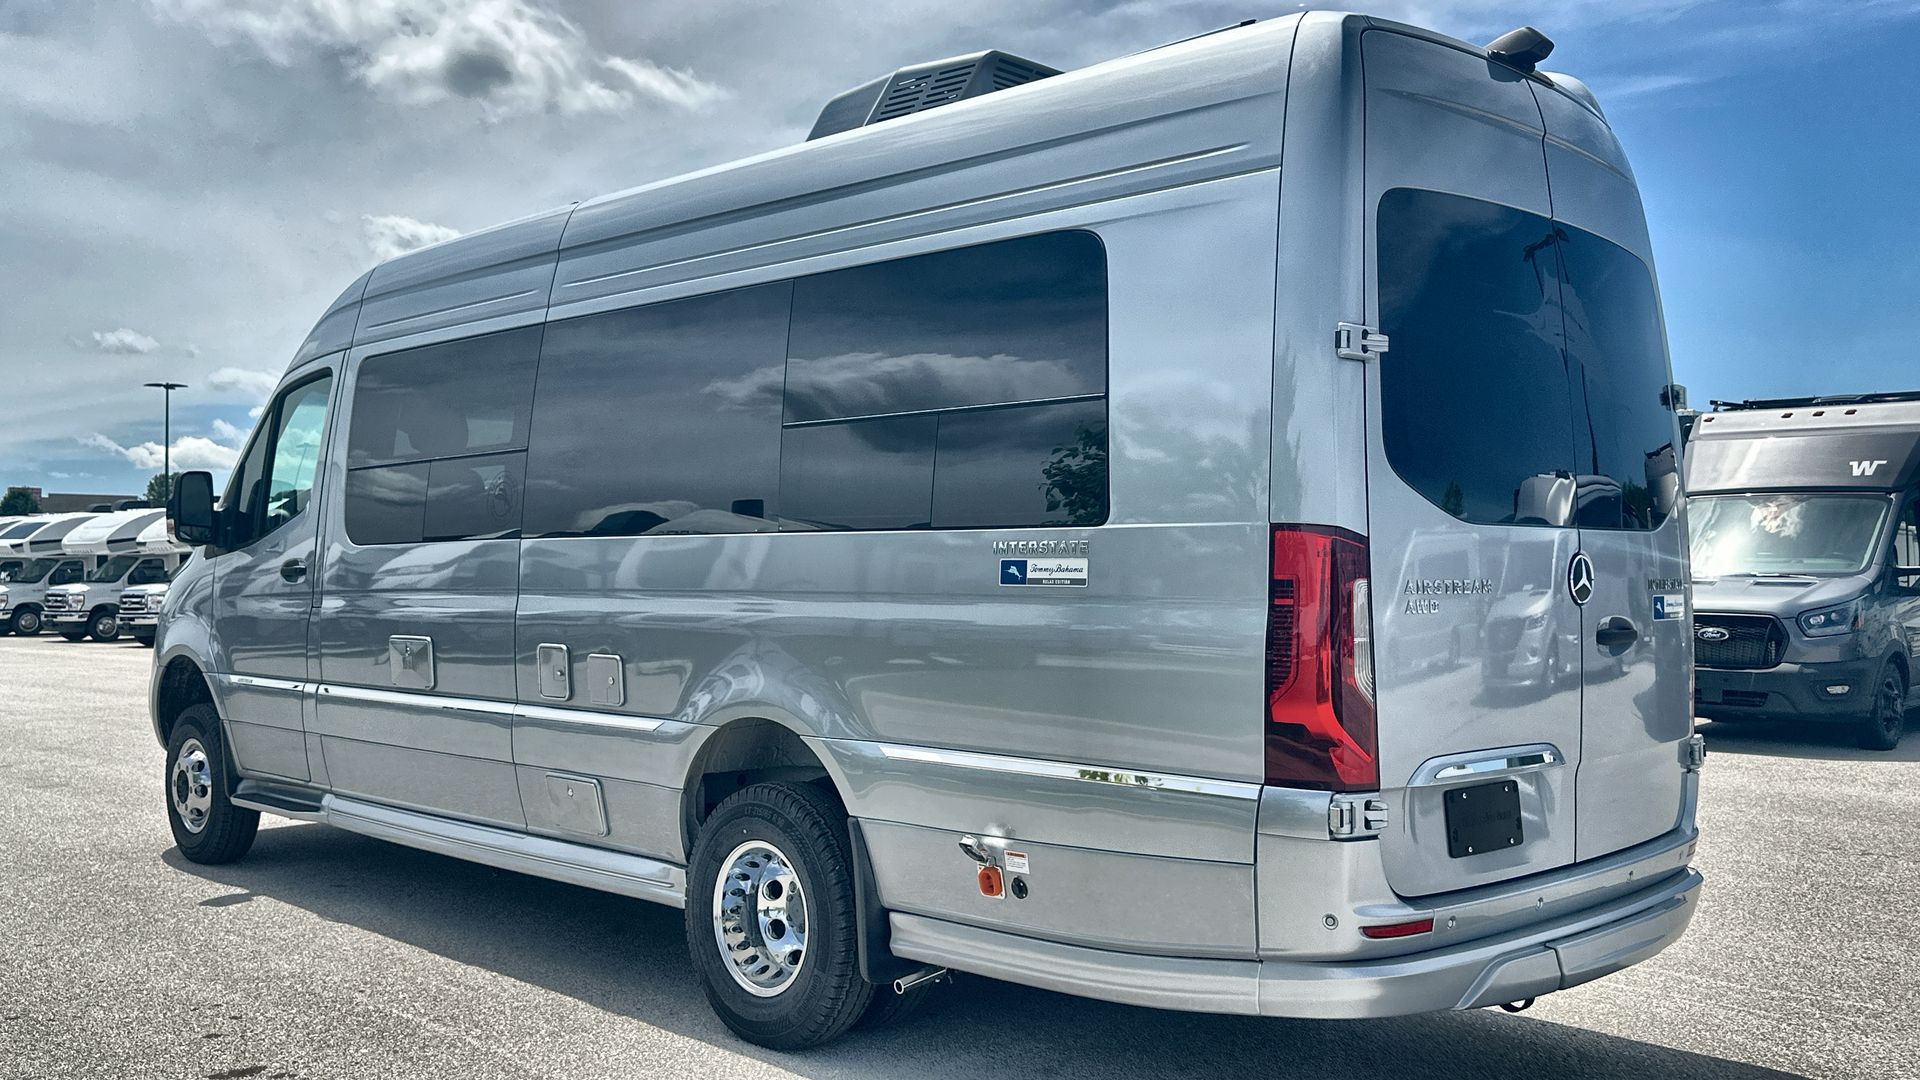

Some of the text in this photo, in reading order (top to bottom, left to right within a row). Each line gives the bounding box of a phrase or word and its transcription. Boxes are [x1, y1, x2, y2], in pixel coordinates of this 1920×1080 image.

[992, 540, 1089, 555] INTERSTATE
[1030, 563, 1083, 576] Tommy Bahama
[1404, 579, 1492, 595] AIRSTREAM
[1405, 599, 1439, 615] AWD
